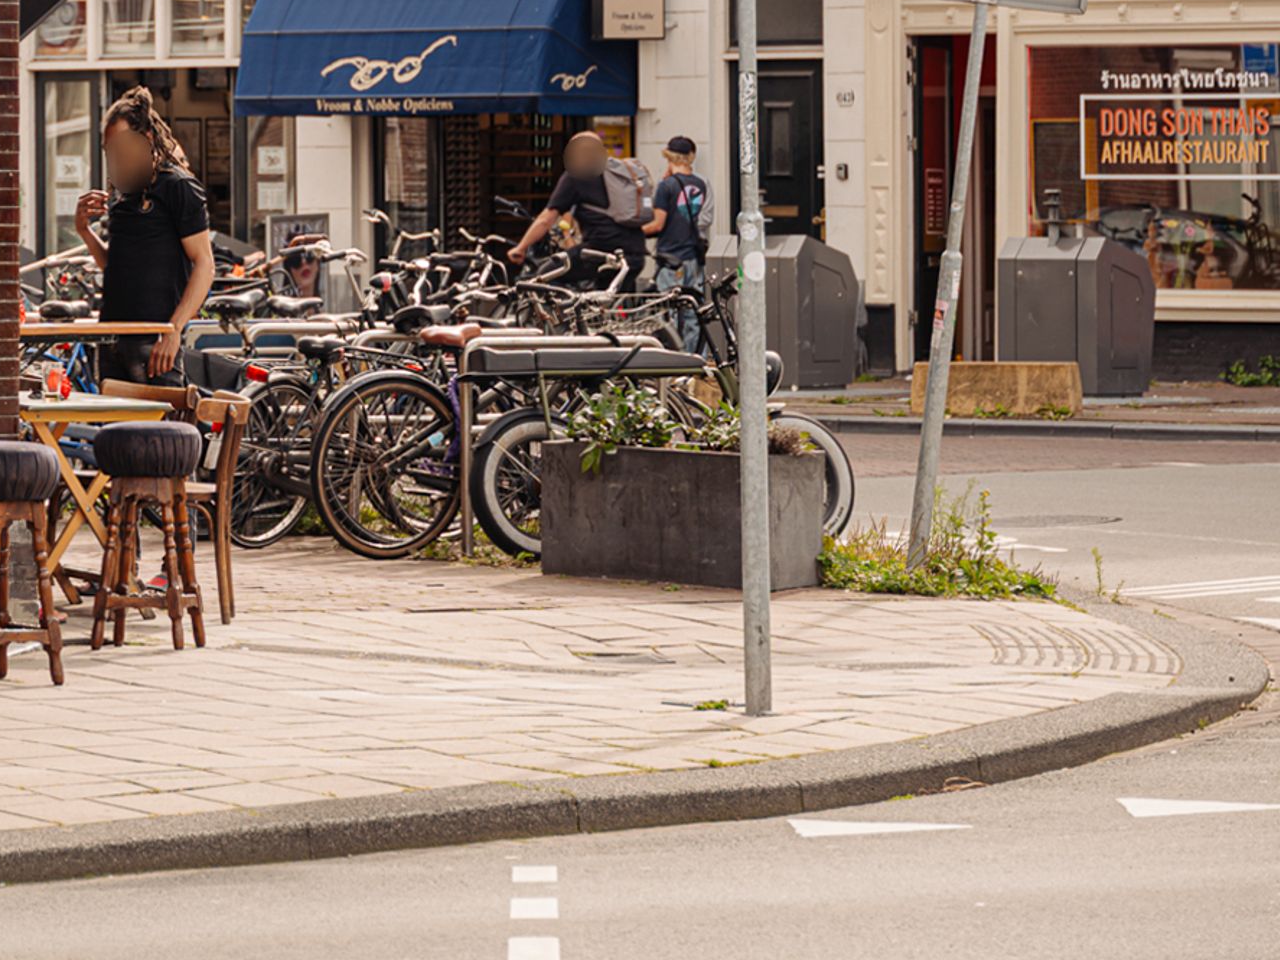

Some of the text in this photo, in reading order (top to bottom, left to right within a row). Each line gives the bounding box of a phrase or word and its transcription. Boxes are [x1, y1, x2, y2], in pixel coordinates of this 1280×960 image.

[353, 98, 363, 112] &
[403, 98, 454, 114] Opticiens
[1100, 107, 1270, 136] DONG SON THAIS
[1100, 140, 1270, 164] AFHAALRESTAURANT
